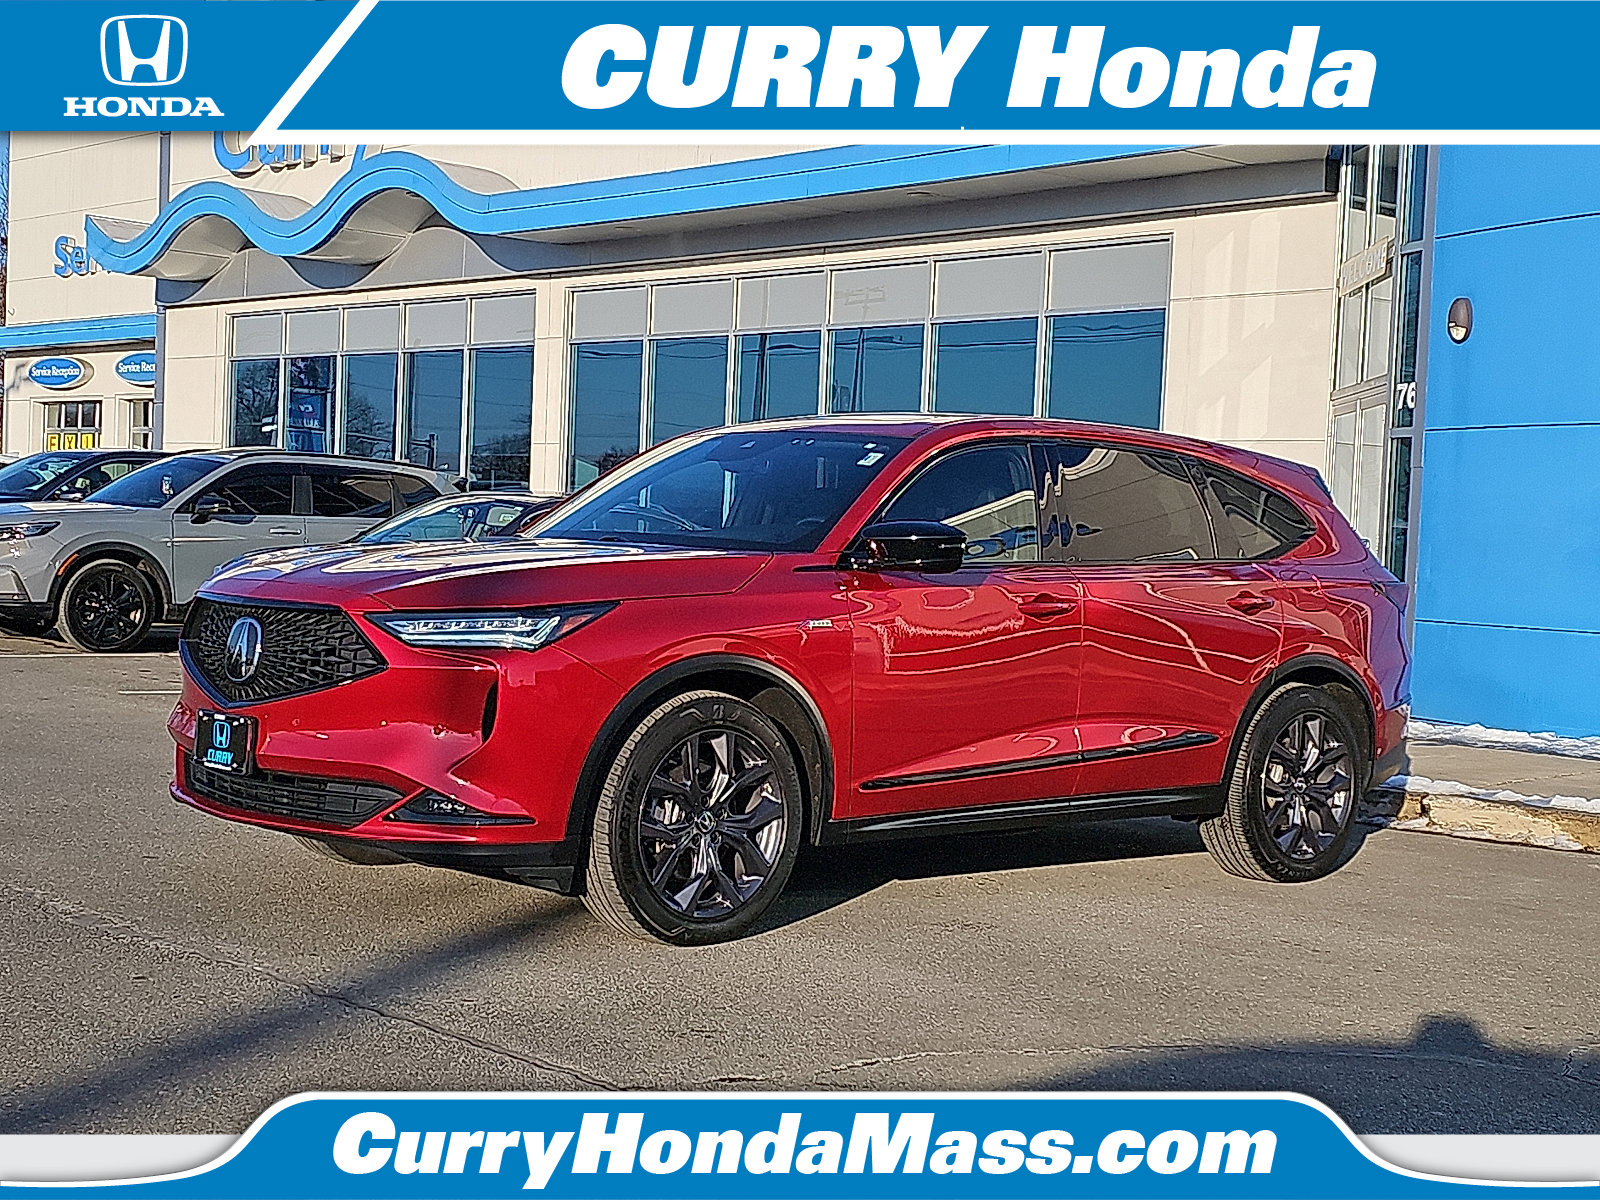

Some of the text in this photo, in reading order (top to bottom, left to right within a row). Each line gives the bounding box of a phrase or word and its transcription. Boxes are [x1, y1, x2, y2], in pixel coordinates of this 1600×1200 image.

[31, 365, 80, 378] Service Reception
[118, 361, 140, 372] Service
[1396, 381, 1416, 410] 76
[207, 749, 233, 764] CURRY
